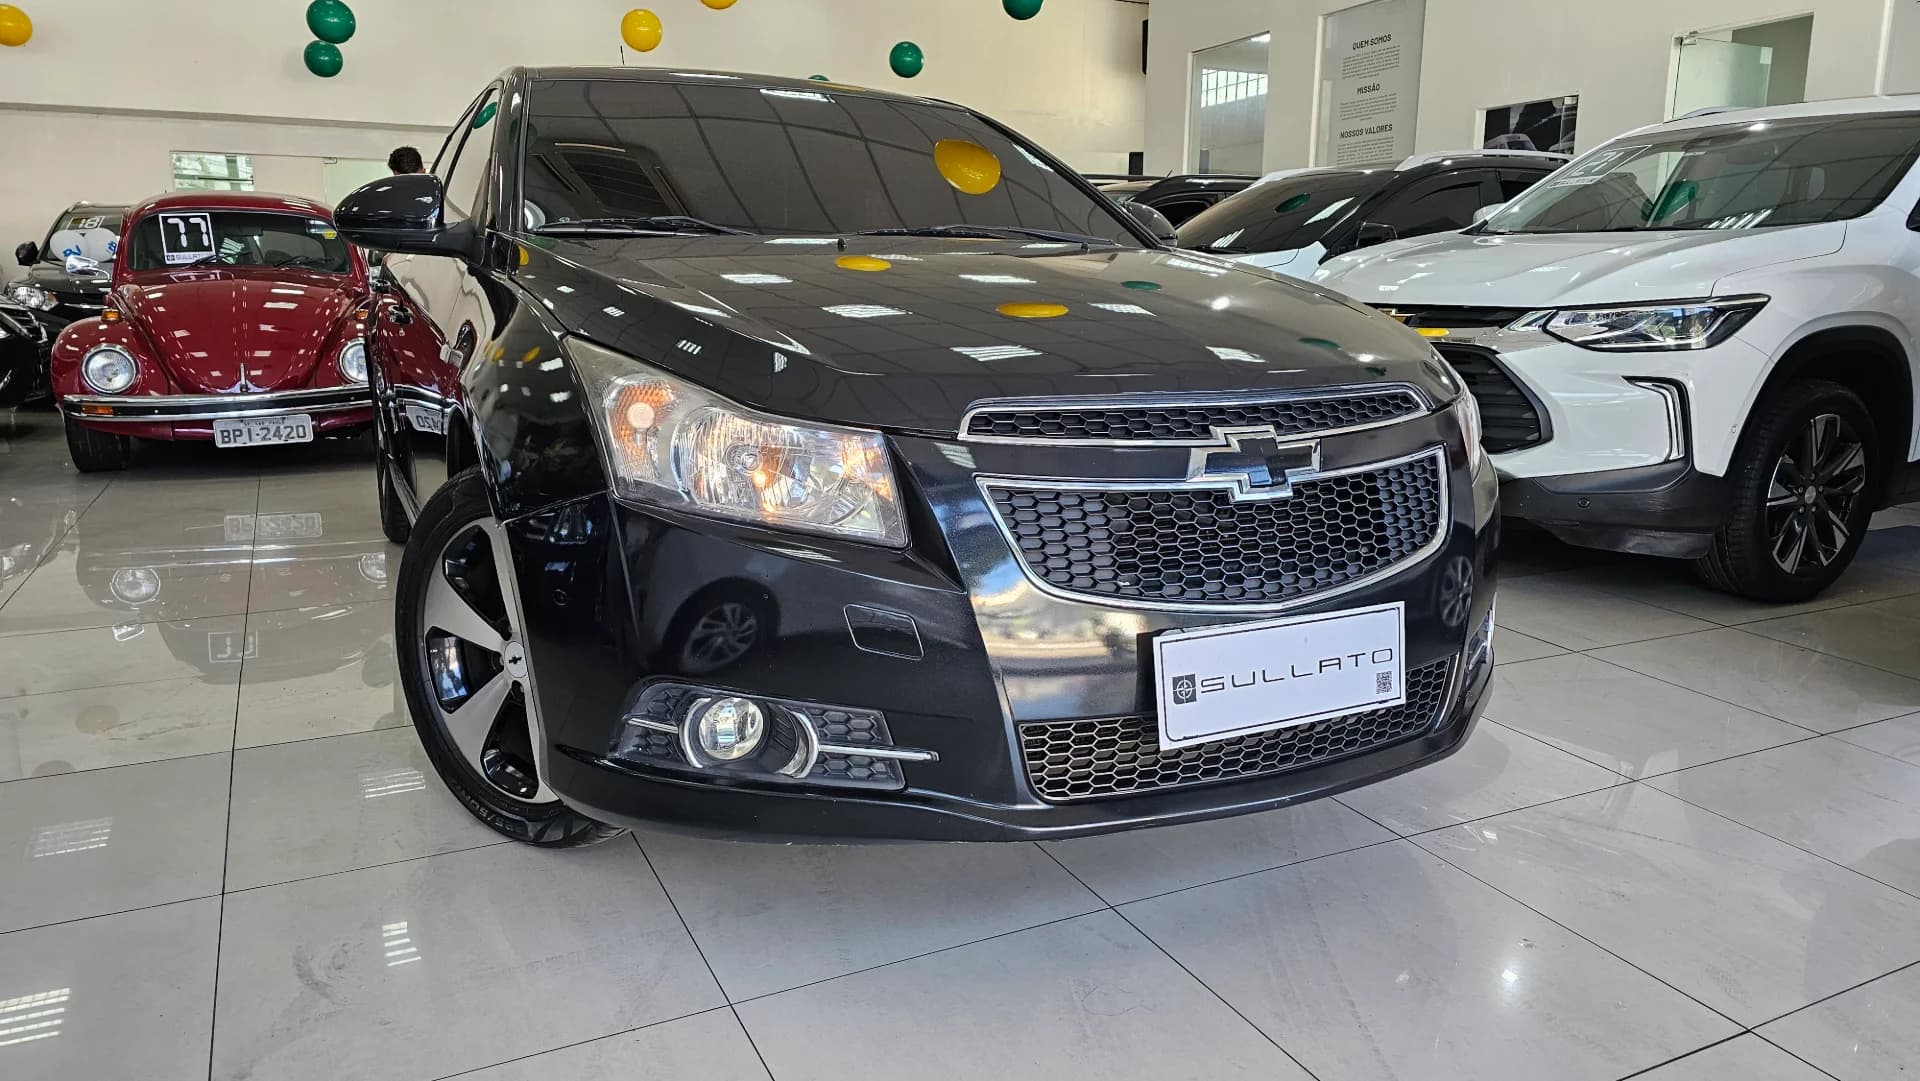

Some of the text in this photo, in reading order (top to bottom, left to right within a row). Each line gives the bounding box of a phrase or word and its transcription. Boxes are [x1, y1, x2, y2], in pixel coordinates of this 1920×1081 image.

[1353, 34, 1392, 50] QUEM SOMOS
[1357, 83, 1381, 95] MISSÃO
[1340, 124, 1393, 139] NOSSOS VALORES
[167, 217, 209, 248] 77
[1200, 648, 1393, 694] SULLATO
